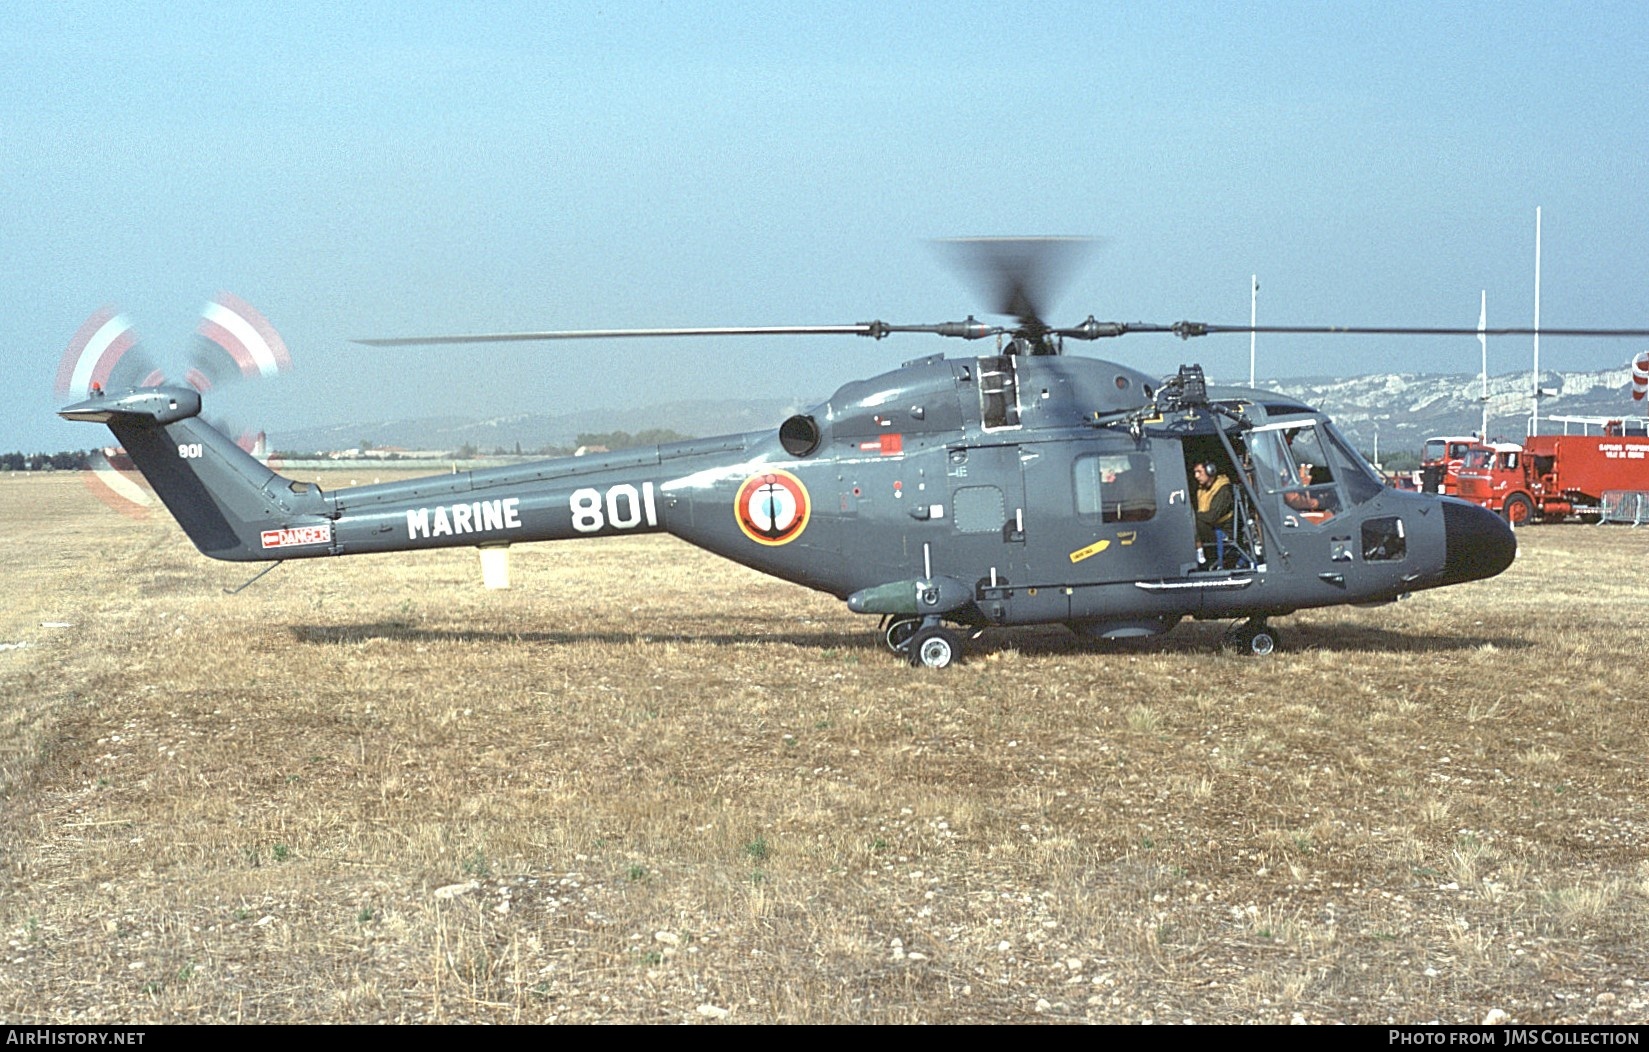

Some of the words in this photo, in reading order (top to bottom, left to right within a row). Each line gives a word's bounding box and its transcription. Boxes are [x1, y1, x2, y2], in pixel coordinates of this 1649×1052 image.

[406, 497, 522, 540] MARINE
[569, 481, 658, 533] 801
[280, 526, 329, 545] DANGER
